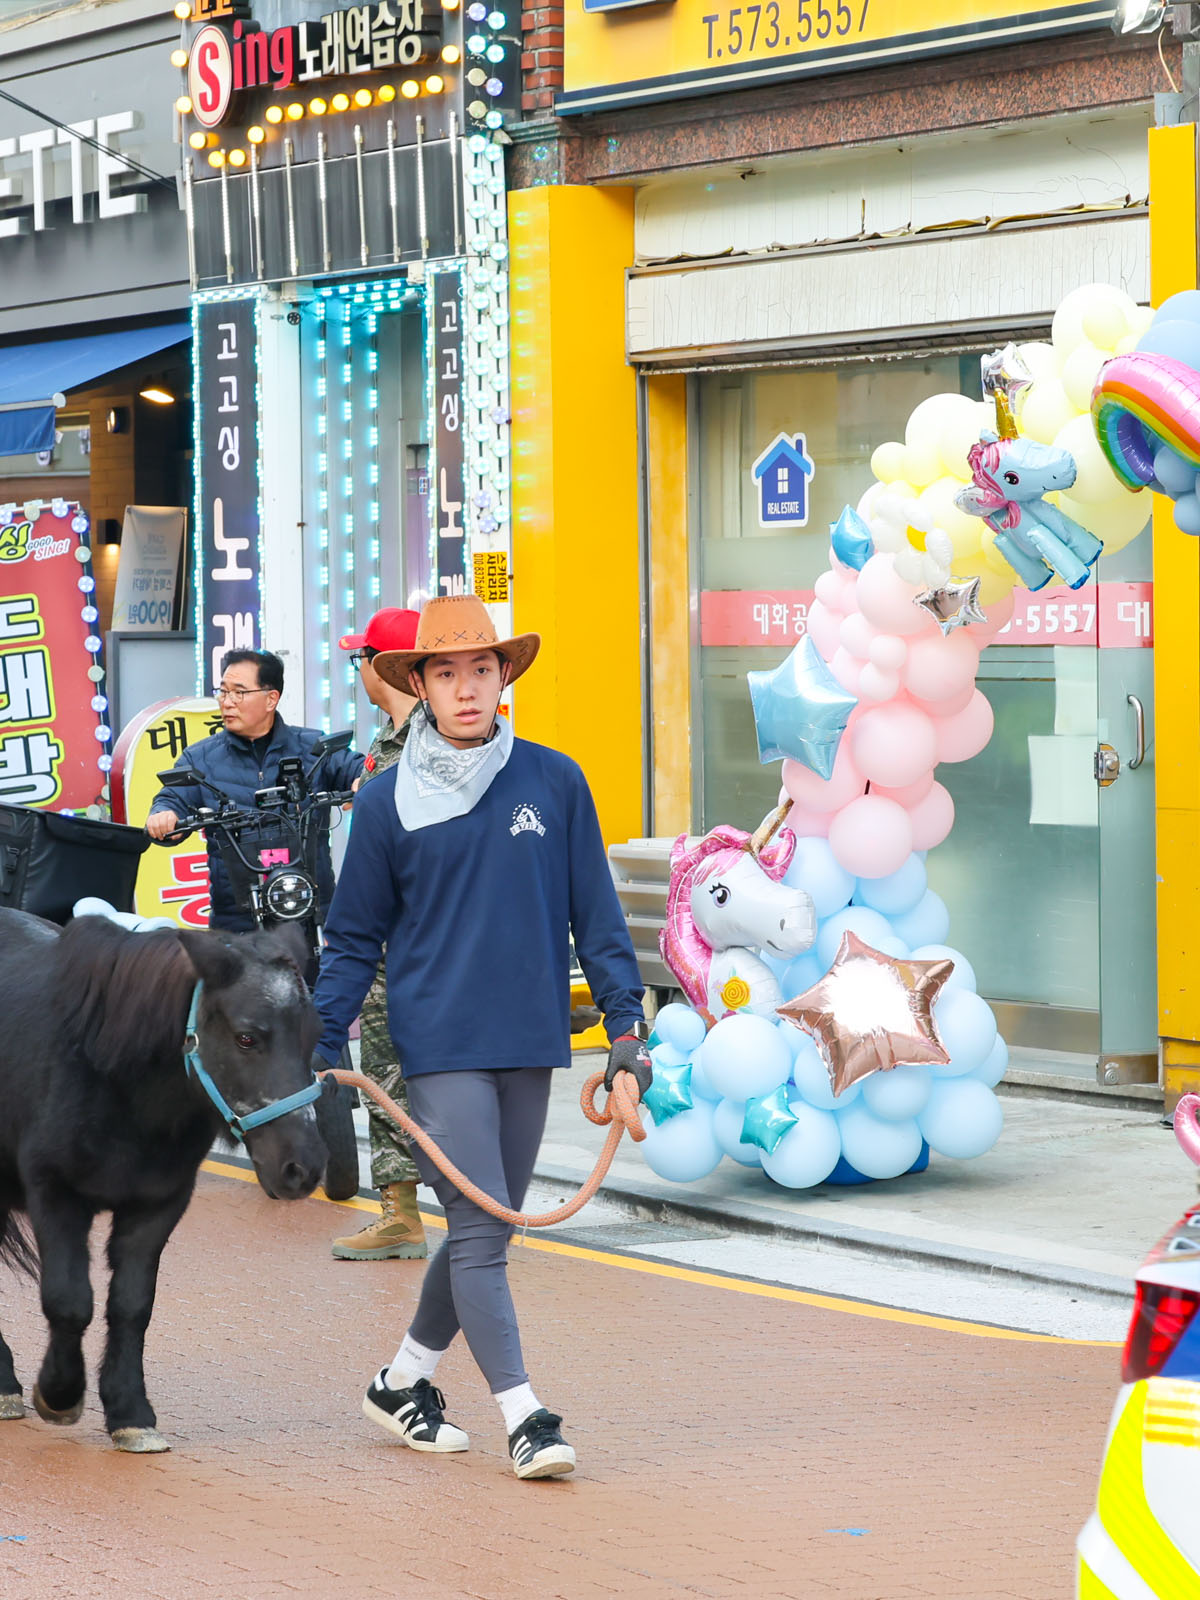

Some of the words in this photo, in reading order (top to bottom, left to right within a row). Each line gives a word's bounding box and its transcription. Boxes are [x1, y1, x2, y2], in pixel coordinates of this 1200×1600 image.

[298, 0, 424, 82] 노래연습장
[702, 0, 869, 58] T.573.5557
[441, 300, 460, 432] 고고싱
[216, 322, 240, 471] 고고싱
[767, 502, 781, 514] REAL
[781, 501, 800, 514] ESTATE
[27, 536, 52, 551] GOGO
[35, 539, 70, 560] SING!
